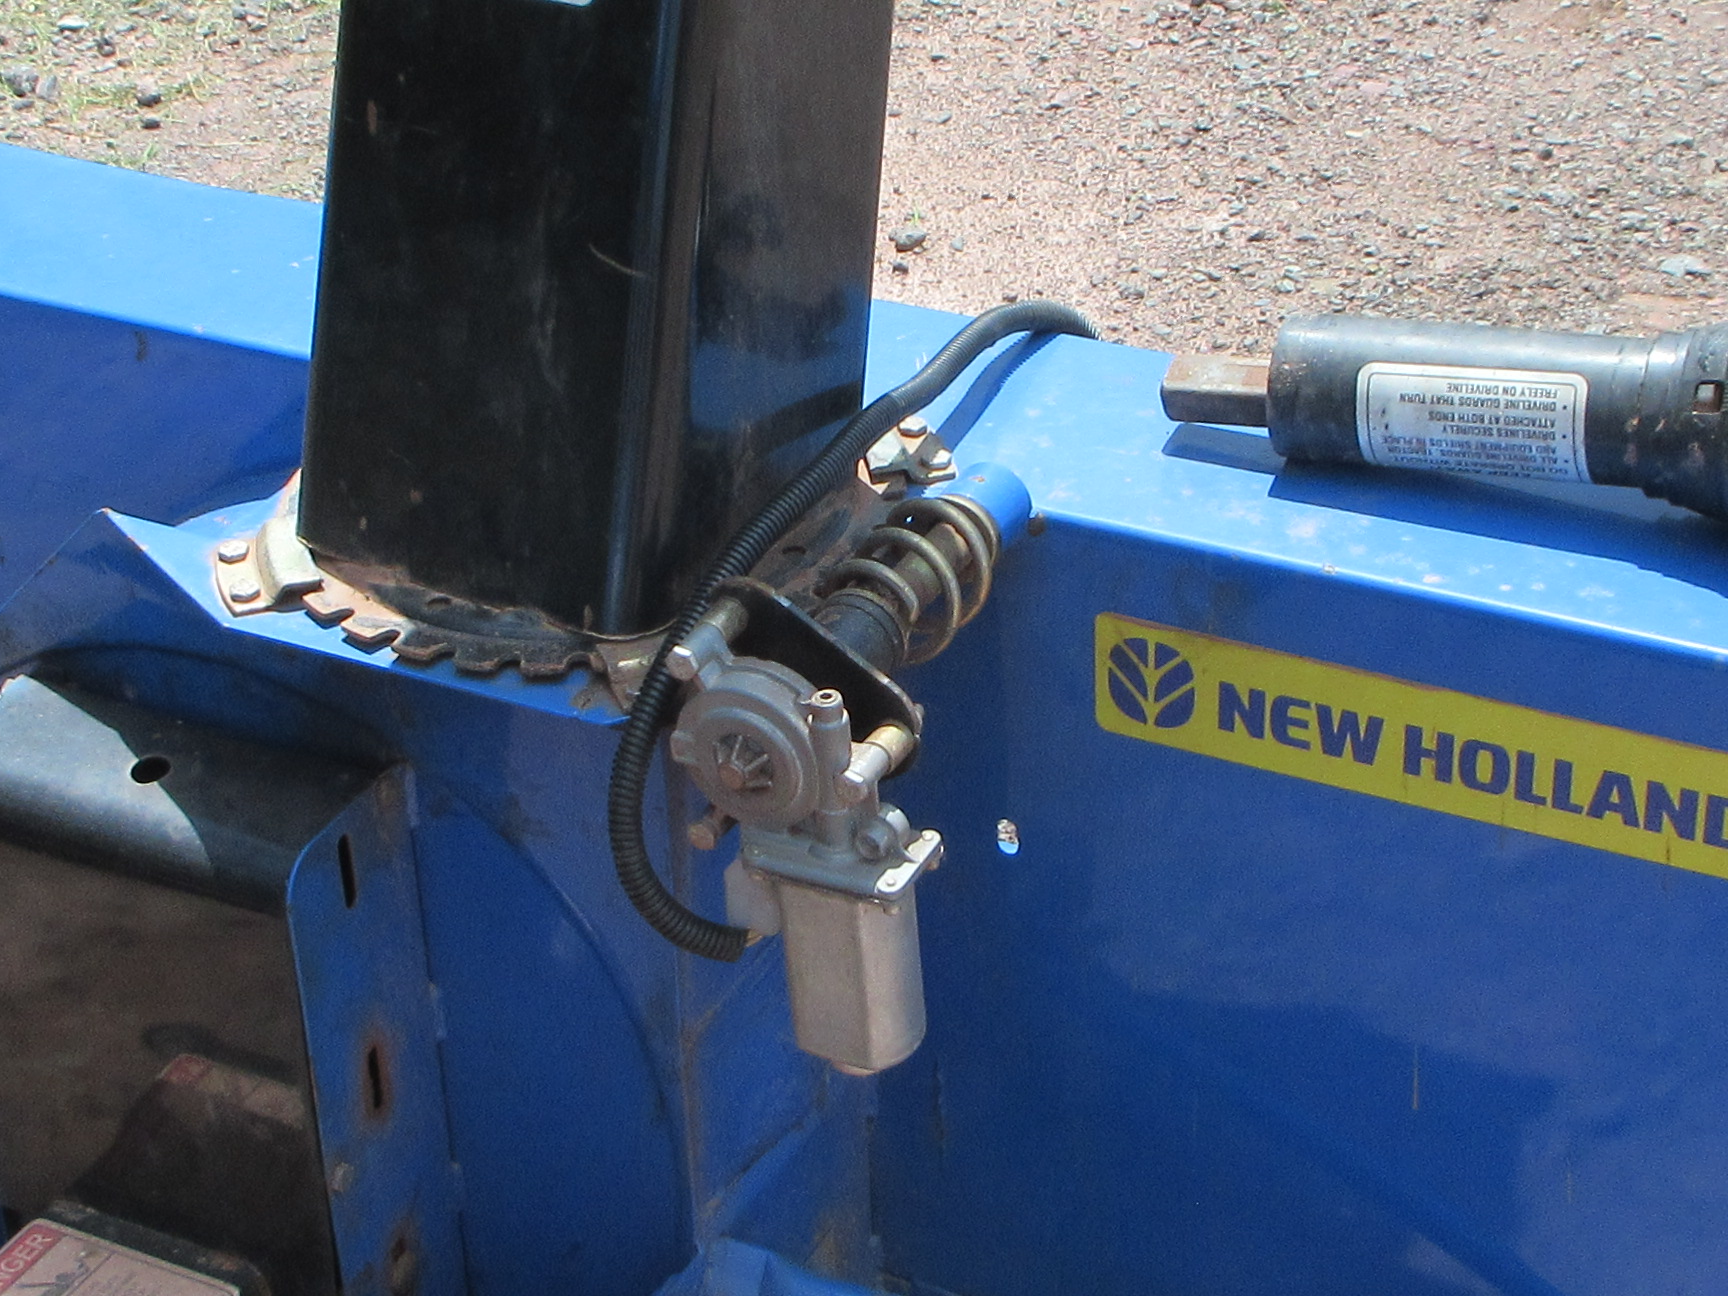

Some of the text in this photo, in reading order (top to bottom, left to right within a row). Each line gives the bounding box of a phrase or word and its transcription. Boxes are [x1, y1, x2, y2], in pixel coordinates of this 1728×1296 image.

[1446, 382, 1558, 398] FREELY ON DRIVELINE
[1398, 393, 1557, 411] DRIVELINE GUARDS THAT TURN
[1427, 411, 1556, 429] ATTACHED AT BOTH ENDS
[1442, 424, 1556, 441] DRIVELINES SECURELY
[1216, 678, 1386, 767] NEW
